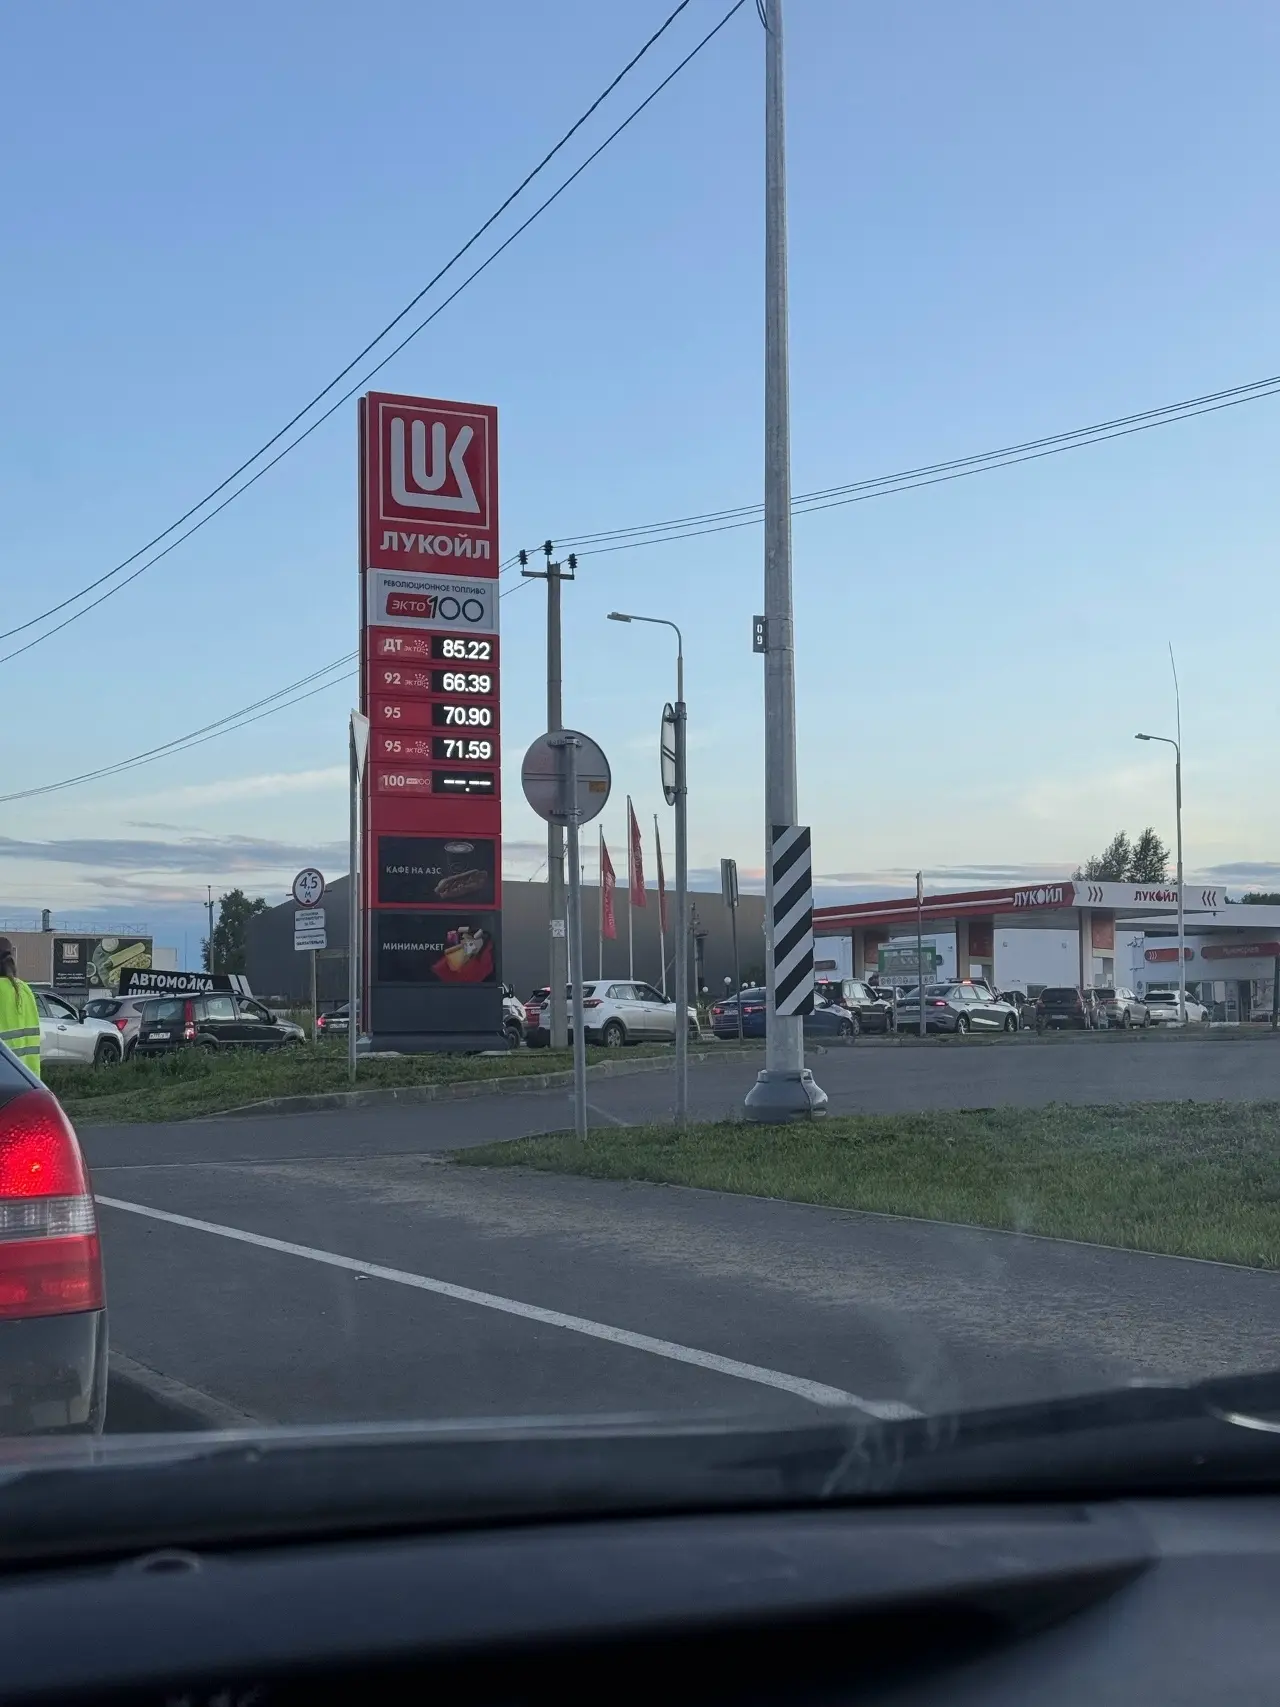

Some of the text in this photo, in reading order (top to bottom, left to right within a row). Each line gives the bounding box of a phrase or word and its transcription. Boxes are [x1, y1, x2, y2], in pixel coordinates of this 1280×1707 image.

[380, 530, 490, 560] ЛУКОЙЛ
[383, 579, 486, 595] РЕВОЛЮЦИОННОЕ ТОПЛИВО
[391, 596, 485, 623] ЭКТО 100
[383, 638, 403, 653] ДТ
[442, 639, 490, 660] 85.22
[384, 672, 401, 685] 92
[442, 673, 490, 693] 66.39
[384, 706, 491, 726] 95 70.90
[384, 740, 402, 752] 95
[443, 740, 491, 759] 71.59
[382, 775, 405, 787] 100
[386, 866, 442, 875] КАФЕ НА АЗС
[300, 876, 318, 890] 4,5
[1012, 885, 1064, 907] ЛУКОЙЛ
[1133, 889, 1179, 903] ЛУКОЙЛ
[382, 942, 445, 951] МИНИМАРКЕТ
[129, 972, 214, 991] АВТОМОЙКА
